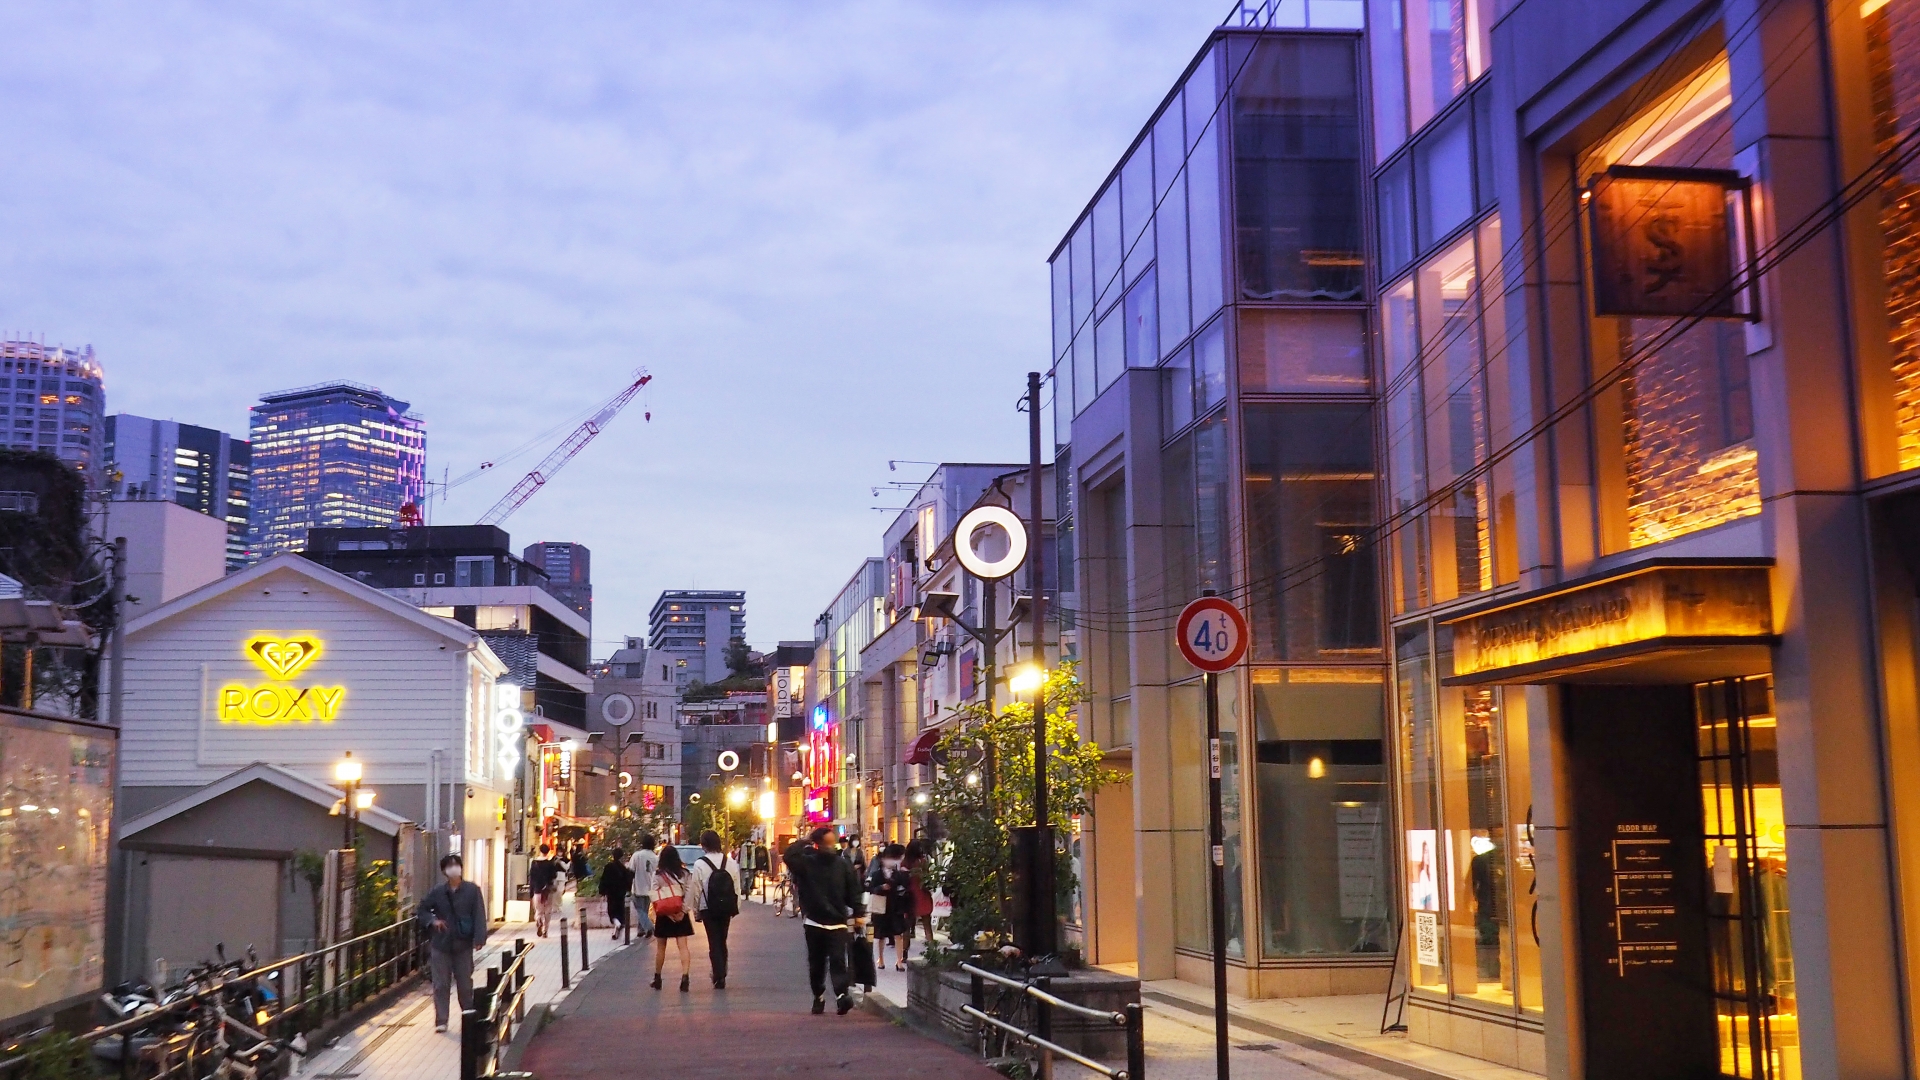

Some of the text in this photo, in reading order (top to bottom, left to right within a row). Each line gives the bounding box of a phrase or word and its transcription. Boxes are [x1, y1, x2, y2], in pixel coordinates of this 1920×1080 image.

[1193, 619, 1229, 655] 4.0
[222, 686, 343, 721] ROXY
[496, 684, 523, 781] ROXY
[1641, 824, 1658, 832] MAP
